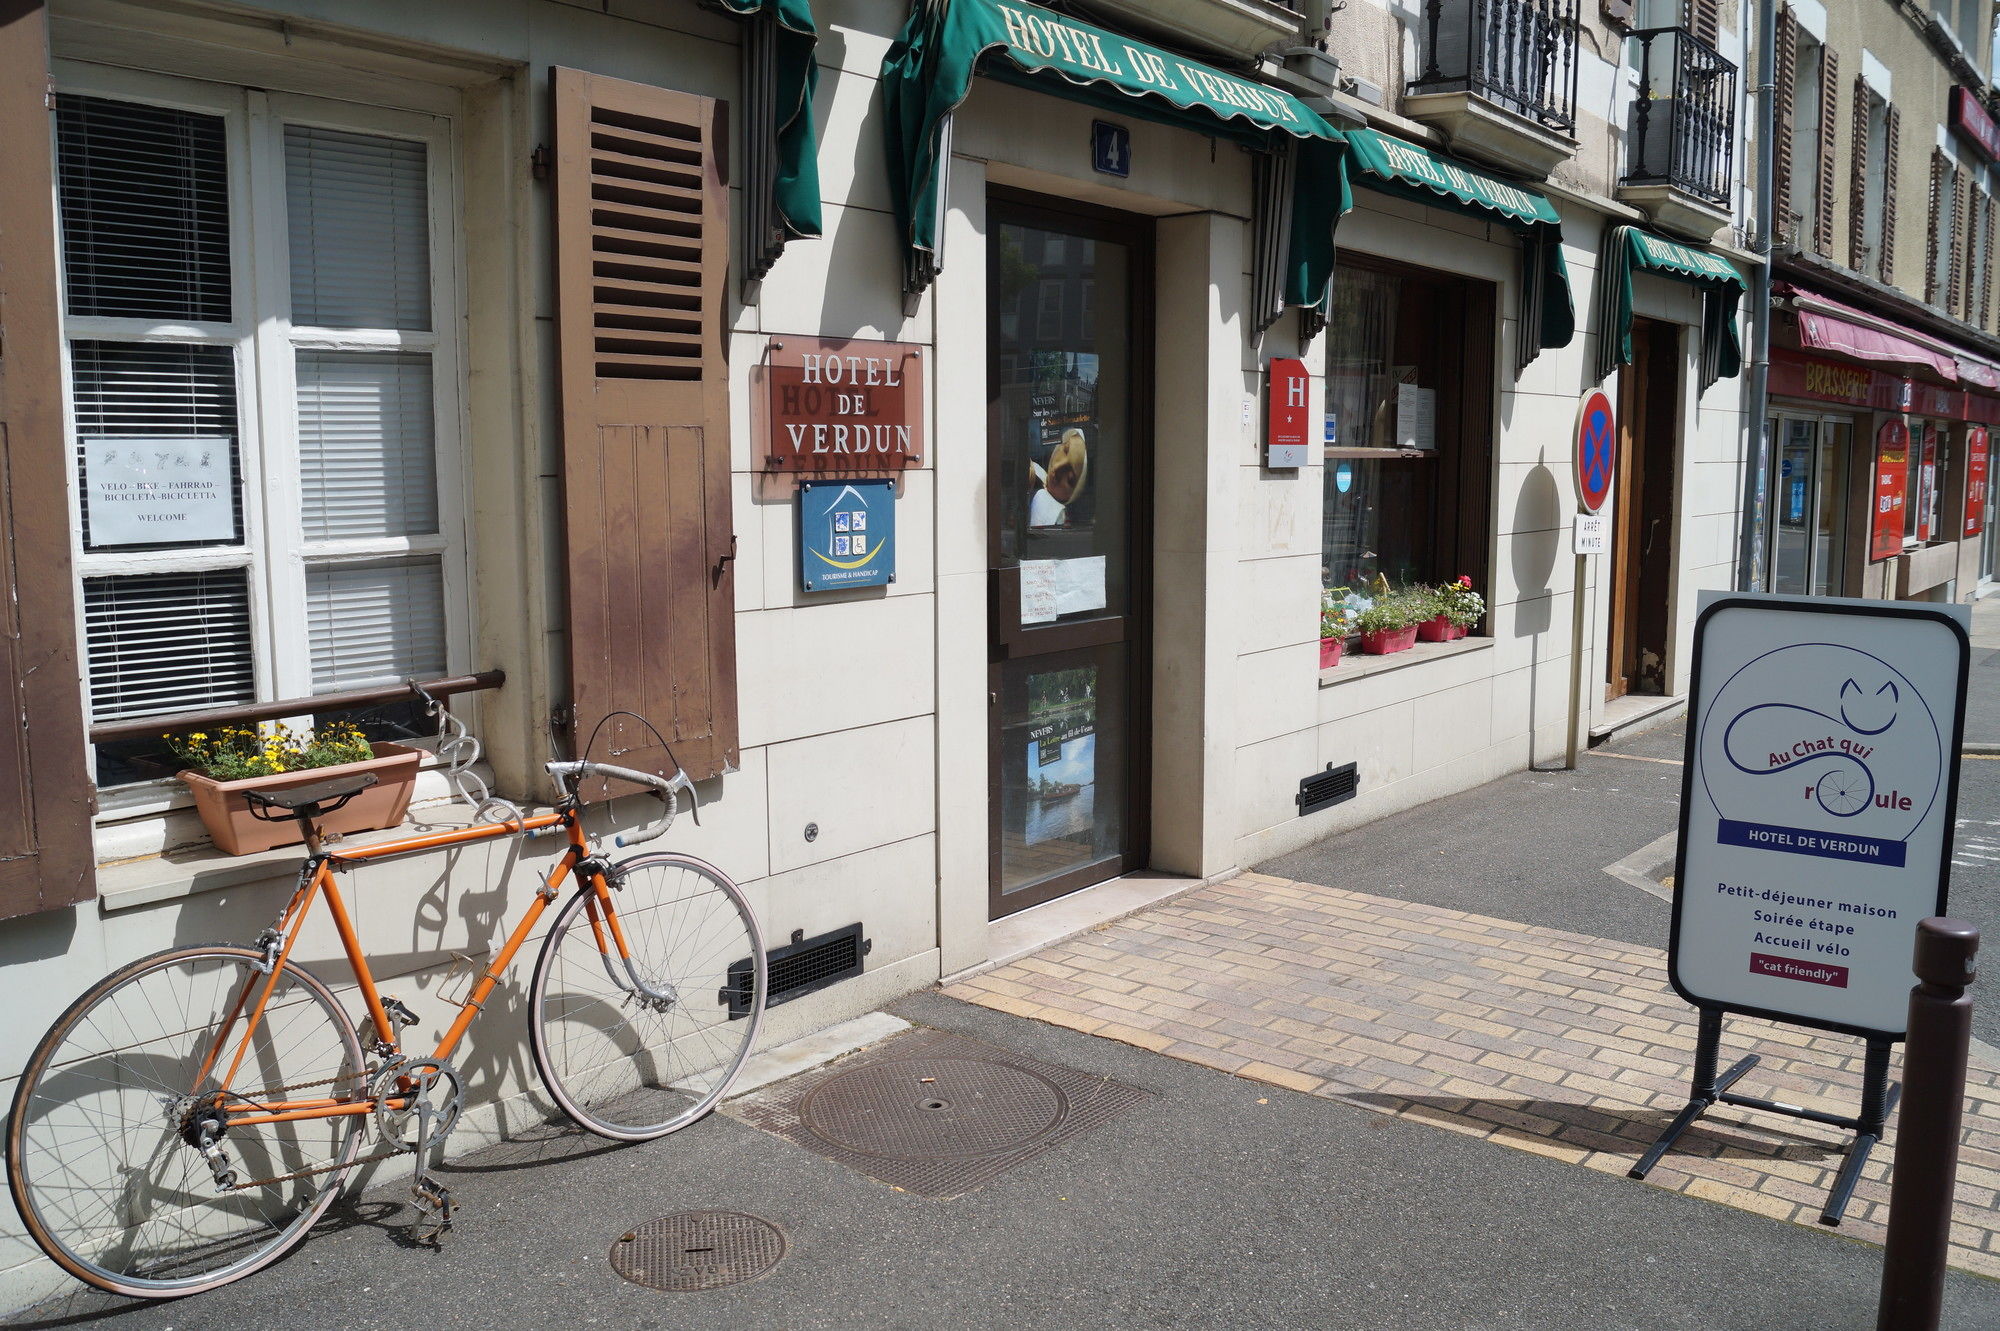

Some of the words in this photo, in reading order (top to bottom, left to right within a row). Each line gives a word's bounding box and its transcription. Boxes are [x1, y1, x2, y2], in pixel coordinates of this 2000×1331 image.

[998, 4, 1123, 77] HOTEL
[1122, 44, 1178, 91] DE
[1175, 62, 1299, 124] VERDUN
[1107, 130, 1119, 170] 4
[1376, 138, 1446, 184] HOTEL
[1441, 161, 1475, 194] DE
[1469, 172, 1538, 216] VERDUN
[1641, 234, 1681, 264] HOTEL
[1673, 245, 1696, 268] DE
[801, 353, 901, 387] HOTEL
[1805, 361, 1870, 400] BRASSERIE
[837, 393, 865, 415] DE
[1286, 376, 1306, 408] H
[785, 423, 912, 454] VERDUN
[100, 482, 127, 491] VELO
[136, 482, 159, 490] BIKE
[168, 481, 213, 490] FAHRRAD
[104, 493, 156, 502] BICICLETA
[137, 513, 187, 522] WELCOME
[1581, 537, 1601, 548] MINUTE
[822, 572, 848, 581] TOURISME
[852, 569, 879, 578] HANDICAP
[1768, 752, 1791, 768] Au
[1792, 736, 1835, 758] Chat
[1839, 738, 1875, 760] qui
[1749, 829, 1794, 847] HOTEL
[1797, 836, 1816, 848] DE
[1820, 838, 1880, 857] VERDUN
[1717, 882, 1833, 910] Petit-déjeuner
[1838, 898, 1898, 919] maison
[1753, 909, 1804, 928] Soirée
[1808, 917, 1855, 936] étape
[1753, 931, 1811, 951] Accueil
[1816, 940, 1850, 957] vélo
